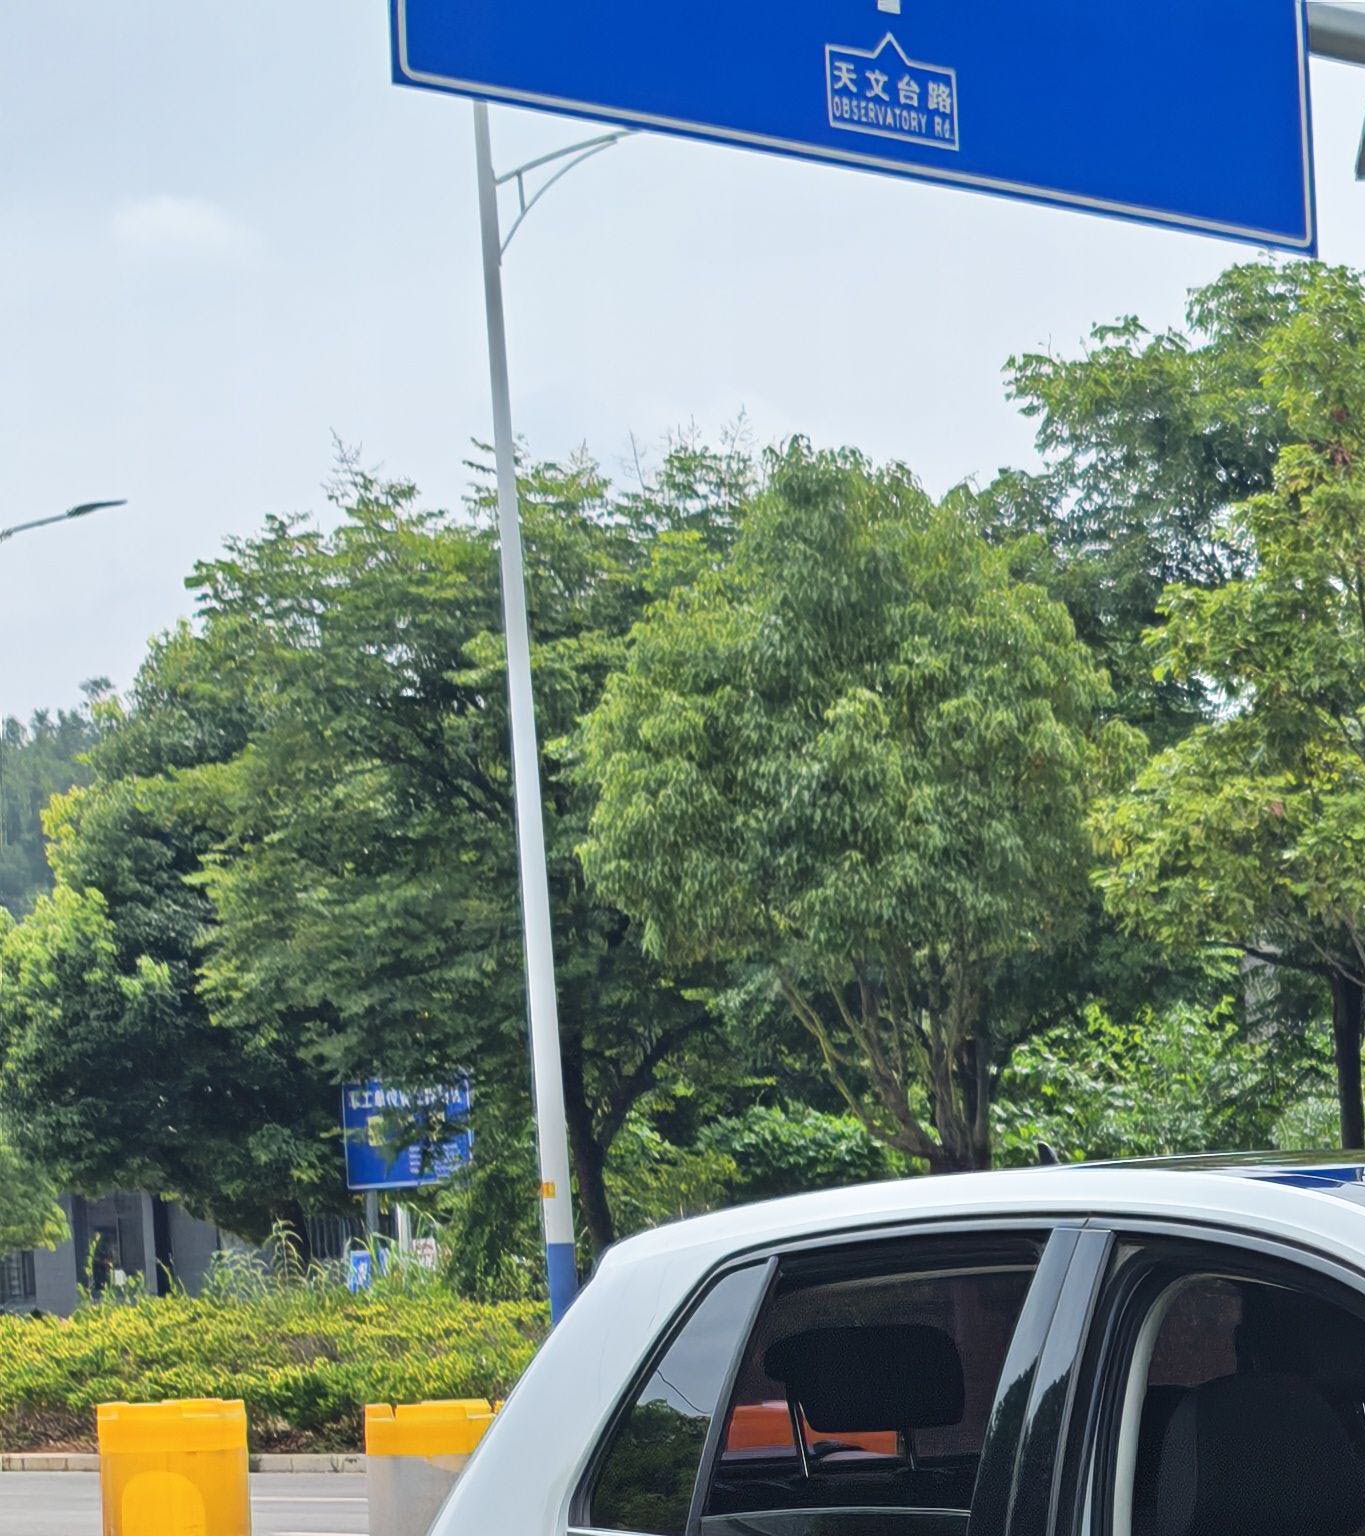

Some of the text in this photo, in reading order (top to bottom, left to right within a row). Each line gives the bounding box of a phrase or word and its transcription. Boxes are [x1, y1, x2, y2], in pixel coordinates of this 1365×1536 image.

[833, 61, 951, 114] 天文台路
[833, 95, 927, 134] OBSERVATORY
